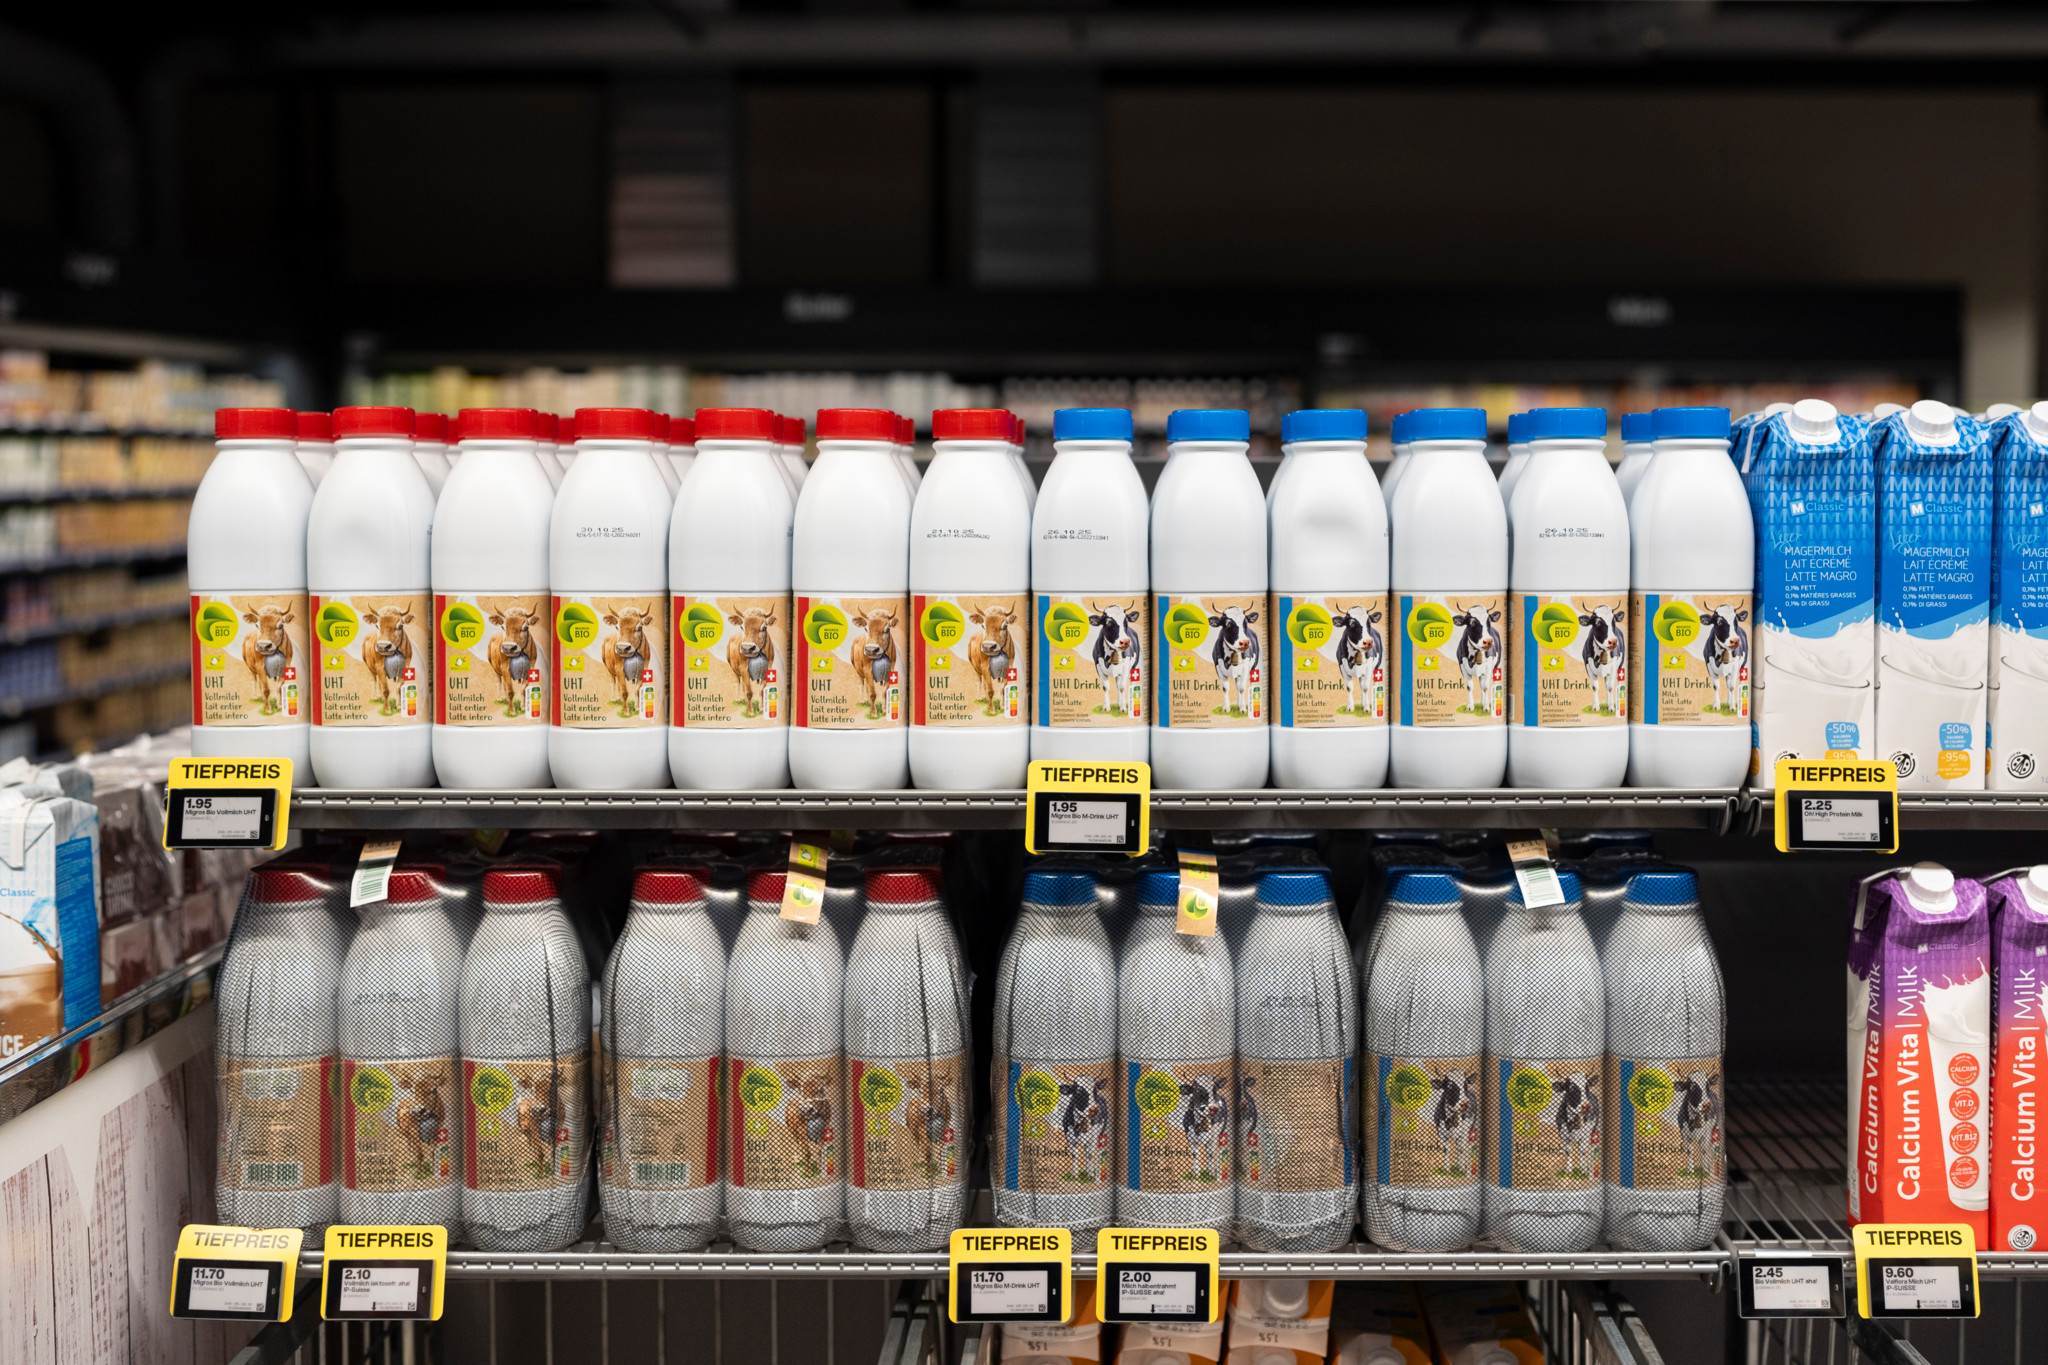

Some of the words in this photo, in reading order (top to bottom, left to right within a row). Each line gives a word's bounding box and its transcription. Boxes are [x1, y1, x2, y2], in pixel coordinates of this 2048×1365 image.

[1806, 502, 1844, 511] Classic
[1925, 504, 1963, 512] Classic
[1785, 546, 1851, 555] MAGERMILCH
[1904, 547, 1969, 557] MAGERMILCH
[1785, 559, 1807, 569] LAIT
[1810, 556, 1851, 568] ÉCRÉMÉ
[1904, 560, 1925, 569] LAIT
[1929, 558, 1968, 569] ÉCRÉMÉ
[1785, 572, 1817, 581] LATTE
[1820, 571, 1857, 580] MAGRO
[1904, 573, 1935, 582] LATTE
[1938, 573, 1973, 582] MAGRO
[335, 629, 349, 637] BIO
[461, 630, 475, 638] BIO
[575, 630, 589, 638] BIO
[700, 630, 714, 638] BIO
[941, 629, 956, 637] BIO
[205, 677, 224, 688] UHT
[324, 677, 343, 689] UHT
[449, 677, 468, 689] UHT
[564, 678, 583, 689] UHT
[689, 678, 707, 689] UHT
[812, 679, 831, 691] UHT
[930, 677, 949, 688] UHT
[1053, 679, 1071, 689] UHT
[1074, 678, 1100, 689] Drink
[1173, 680, 1190, 690] UHT
[1194, 680, 1220, 691] Drink
[1297, 680, 1314, 690] UHT
[1318, 679, 1344, 690] Drink
[1417, 679, 1434, 689] UHT
[1438, 678, 1464, 689] Drink
[1542, 679, 1560, 689] UHT
[1564, 678, 1590, 689] Drink
[1663, 677, 1681, 688] UHT
[1684, 677, 1711, 688] Drink
[205, 693, 240, 701] Vollmilch
[324, 693, 359, 701] Vollmilch
[449, 694, 484, 702] Vollmilch
[564, 694, 598, 702] Vollmilch
[688, 694, 723, 702] Vollmilch
[812, 696, 847, 704] Vollmilch
[929, 693, 965, 701] Vollmilch
[929, 712, 947, 720] Latte
[1828, 723, 1856, 733] -50%
[1942, 724, 1968, 734] -50%
[1941, 752, 1968, 762] -95%
[182, 765, 280, 778] TIEFPREIS
[1041, 767, 1138, 783] TIEFPREIS
[1788, 767, 1885, 782] TIEFPREIS
[186, 799, 212, 808] 1.95
[1052, 803, 1077, 812] 1.95
[1804, 801, 1832, 810] 2.25
[0, 888, 36, 897] Classic
[1869, 962, 1881, 1017] Milk
[1898, 965, 1918, 1018] Milk
[2014, 968, 2035, 1019] Milk
[1866, 1030, 1879, 1079] Vita
[1898, 1033, 1919, 1086] Vita
[2013, 1037, 2035, 1088] Vita
[1865, 1085, 1879, 1194] Calcium
[1951, 1133, 1977, 1141] VIT.B12
[1898, 1089, 1920, 1200] Calcium
[2011, 1093, 2035, 1201] Calcium
[194, 1232, 289, 1249] TIEFPREIS
[337, 1233, 433, 1248] TIEFPREIS
[963, 1235, 1059, 1251] TIEFPREIS
[1111, 1235, 1207, 1251] TIEFPREIS
[1866, 1231, 1962, 1246] TIEFPREIS
[194, 1269, 225, 1279] 11.70
[345, 1270, 370, 1279] 2.10
[974, 1272, 1004, 1282] 11.70
[1122, 1272, 1151, 1282] 2.00
[1755, 1268, 1783, 1278] 2.45
[1885, 1268, 1914, 1278] 9.60
